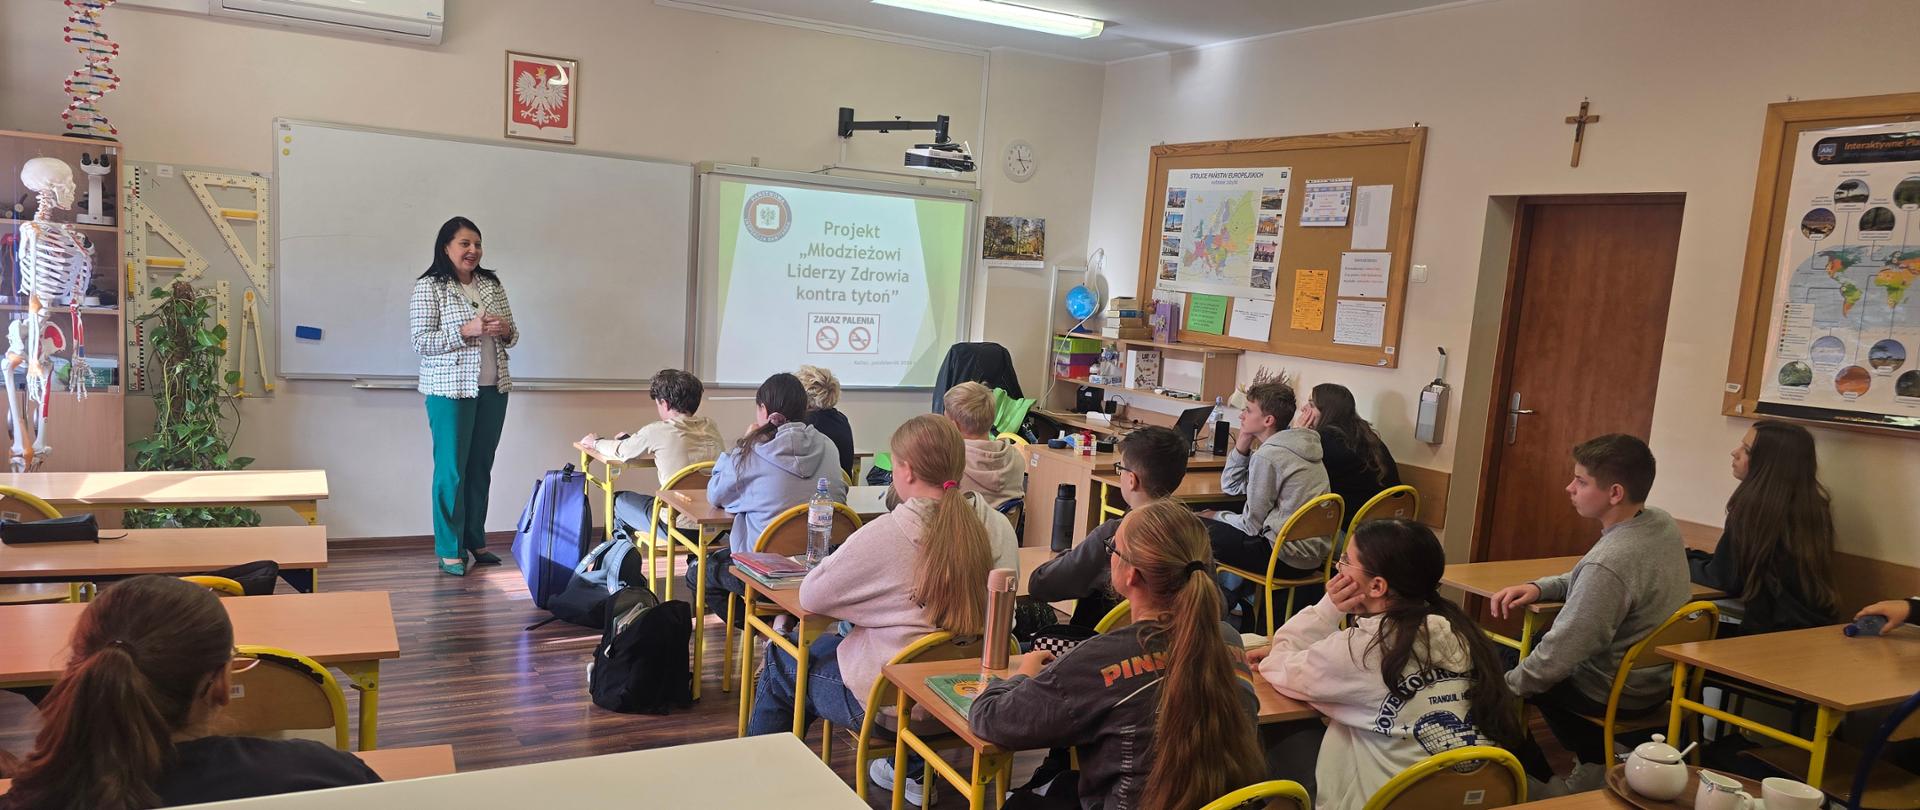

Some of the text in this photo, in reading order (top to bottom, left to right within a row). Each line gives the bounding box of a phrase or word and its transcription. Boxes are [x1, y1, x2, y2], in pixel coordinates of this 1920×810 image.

[1845, 141, 1904, 151] Interaktywne
[1190, 170, 1264, 180] STOLICE PAŃSTW EUROPEJSKICH
[824, 221, 881, 240] Projekt
[800, 242, 901, 262] „Młodzieżowi
[787, 263, 910, 283] Liderzy Zdrowia
[796, 285, 847, 302] kontra
[813, 315, 875, 325] ZAKAZ PALENIA
